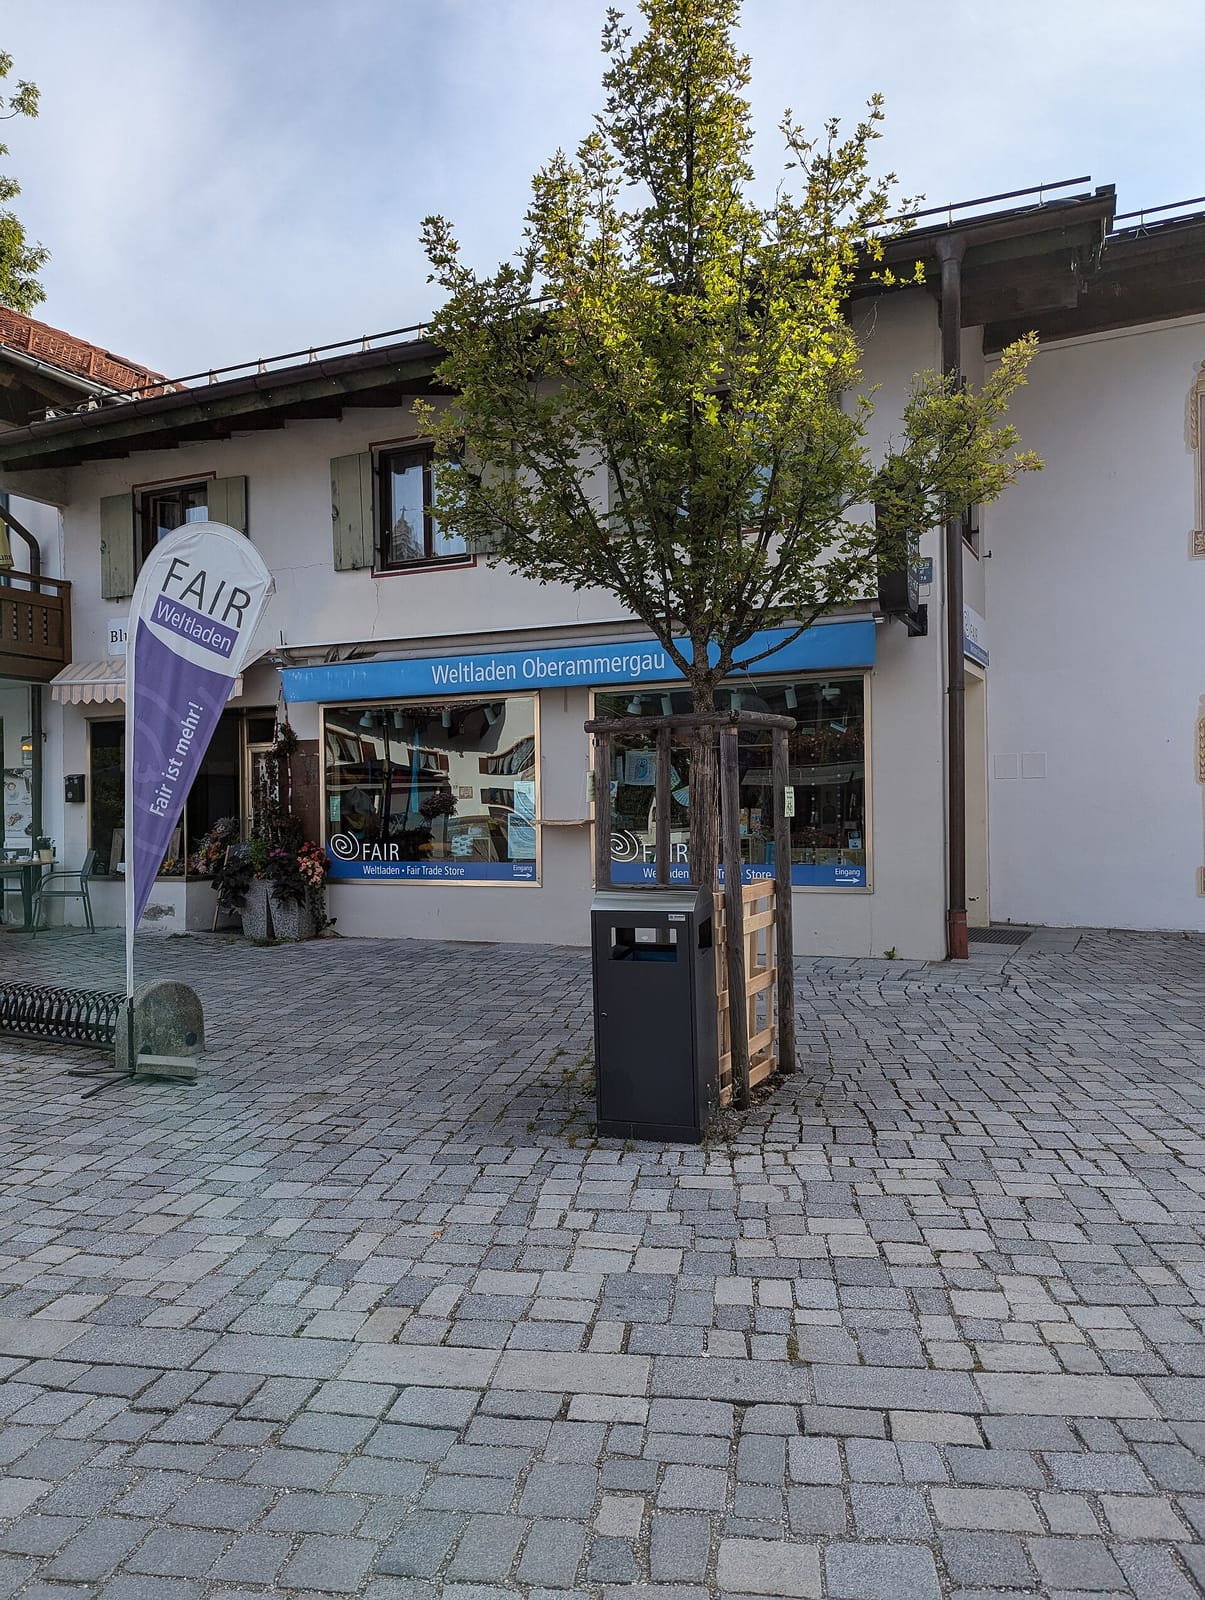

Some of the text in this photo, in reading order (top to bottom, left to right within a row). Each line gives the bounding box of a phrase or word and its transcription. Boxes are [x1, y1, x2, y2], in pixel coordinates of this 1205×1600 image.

[161, 557, 251, 628] FAIR
[157, 601, 231, 652] Weltladen
[431, 653, 665, 685] Weltladen Oberammergau
[149, 701, 204, 817] Fair ist mehr!
[362, 843, 400, 861] FAIR
[643, 843, 688, 863] FIR
[363, 865, 465, 876] Weltladen Fair Trade Store
[513, 864, 533, 873] Eingang
[746, 868, 772, 880] Store
[834, 867, 861, 877] Eingang
